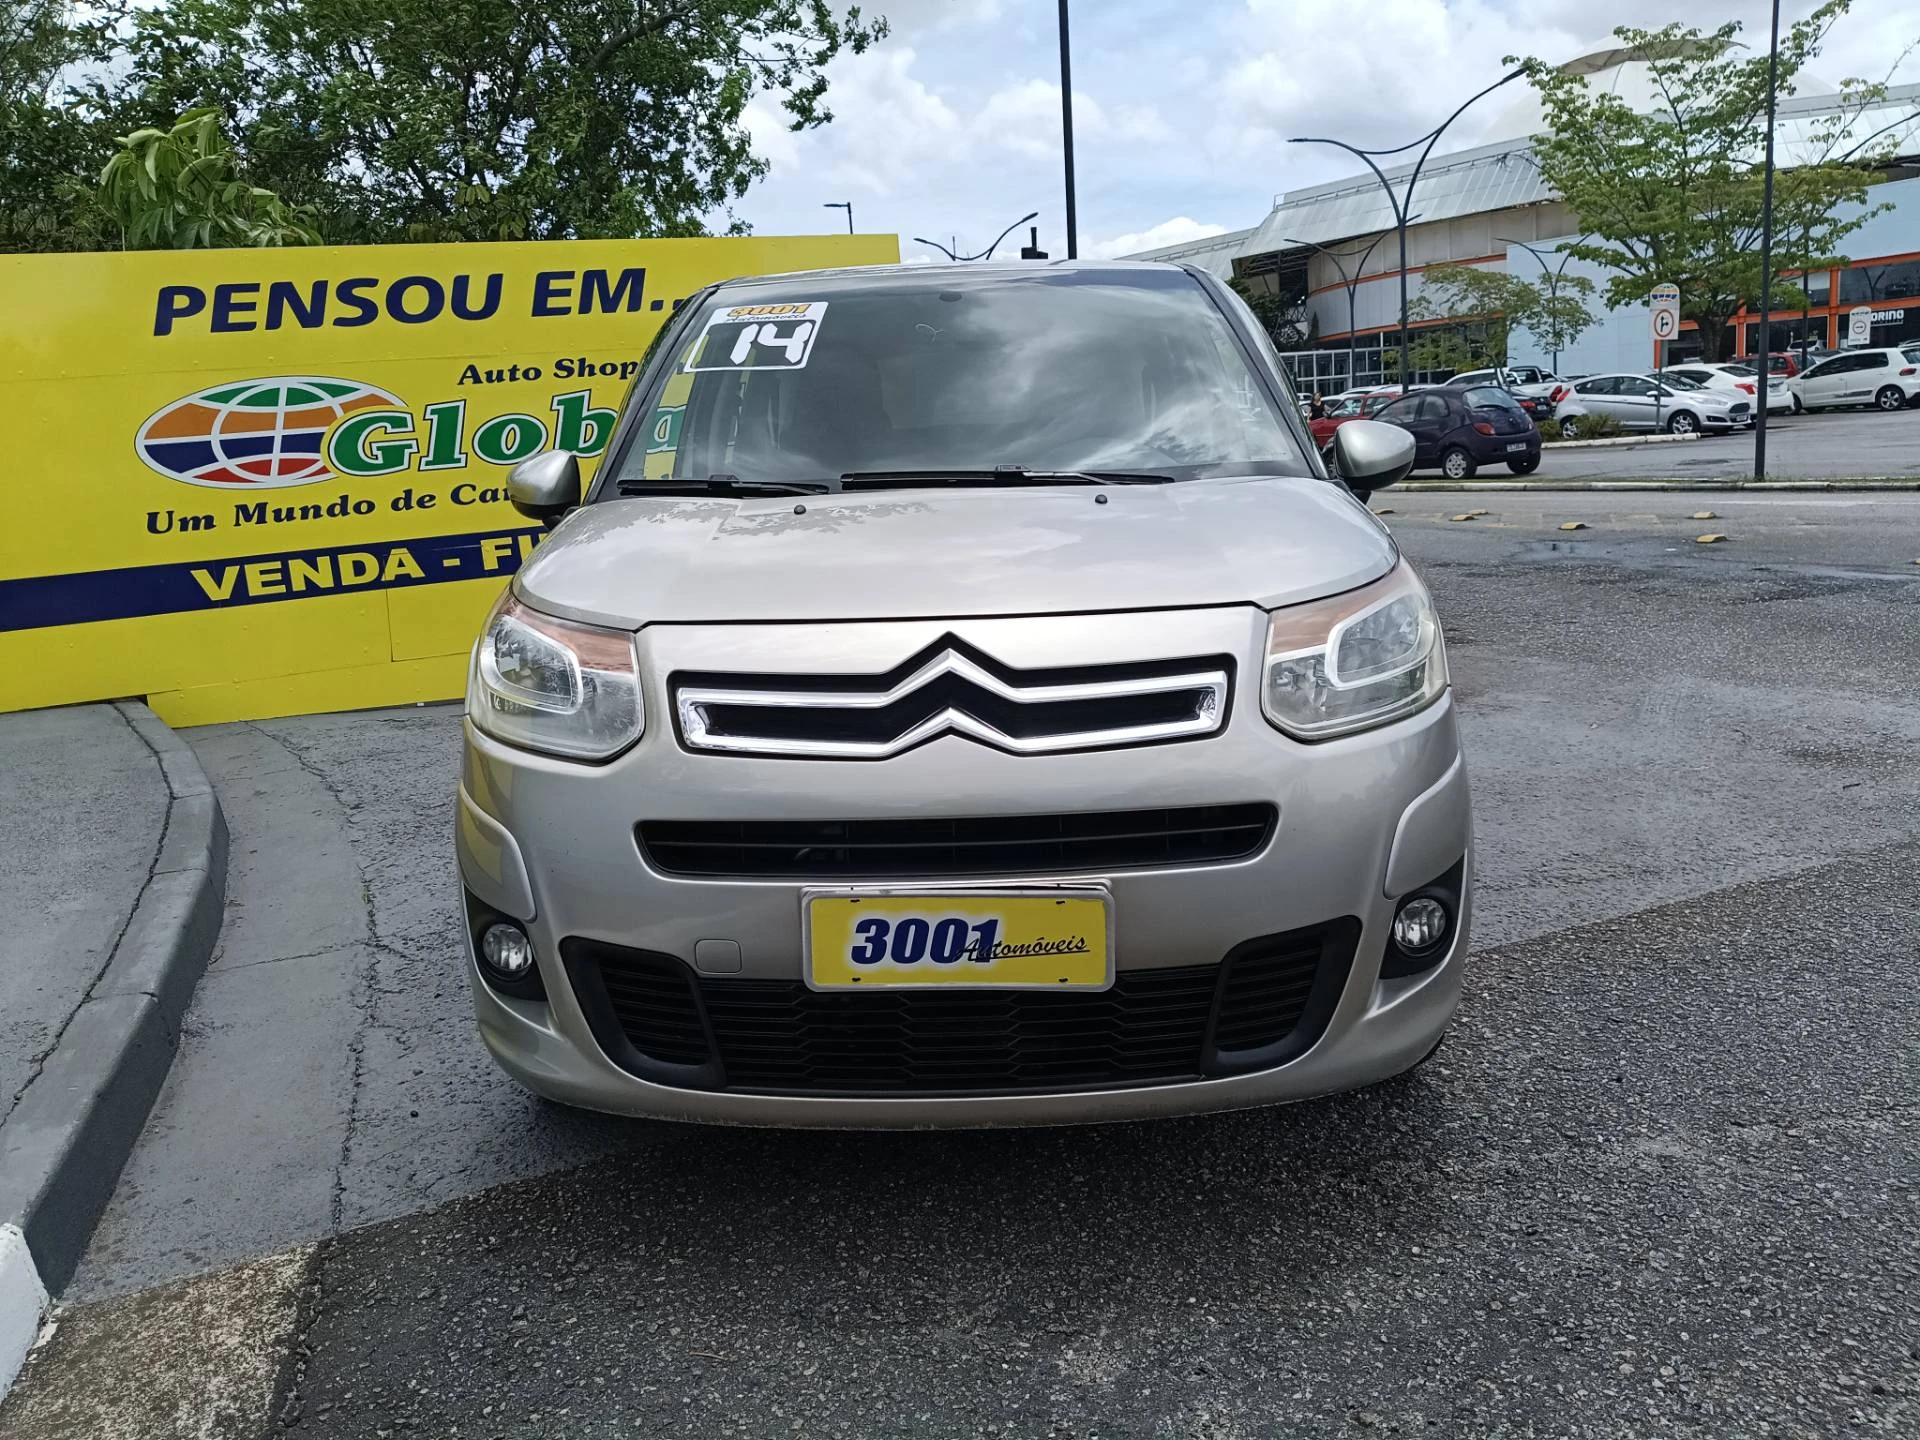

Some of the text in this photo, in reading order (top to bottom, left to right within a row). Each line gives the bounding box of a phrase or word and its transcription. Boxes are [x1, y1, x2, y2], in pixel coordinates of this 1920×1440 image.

[153, 273, 504, 336] PENSOU
[729, 321, 813, 366] 14
[457, 357, 639, 386] Auto Shop
[327, 385, 741, 477] Globa
[146, 510, 217, 535] Um
[233, 494, 376, 527] Mundo
[391, 488, 436, 512] de
[190, 548, 426, 601] VENDA
[480, 533, 547, 571] FI
[851, 918, 999, 964] 3001
[960, 935, 1088, 962] Automóveis
